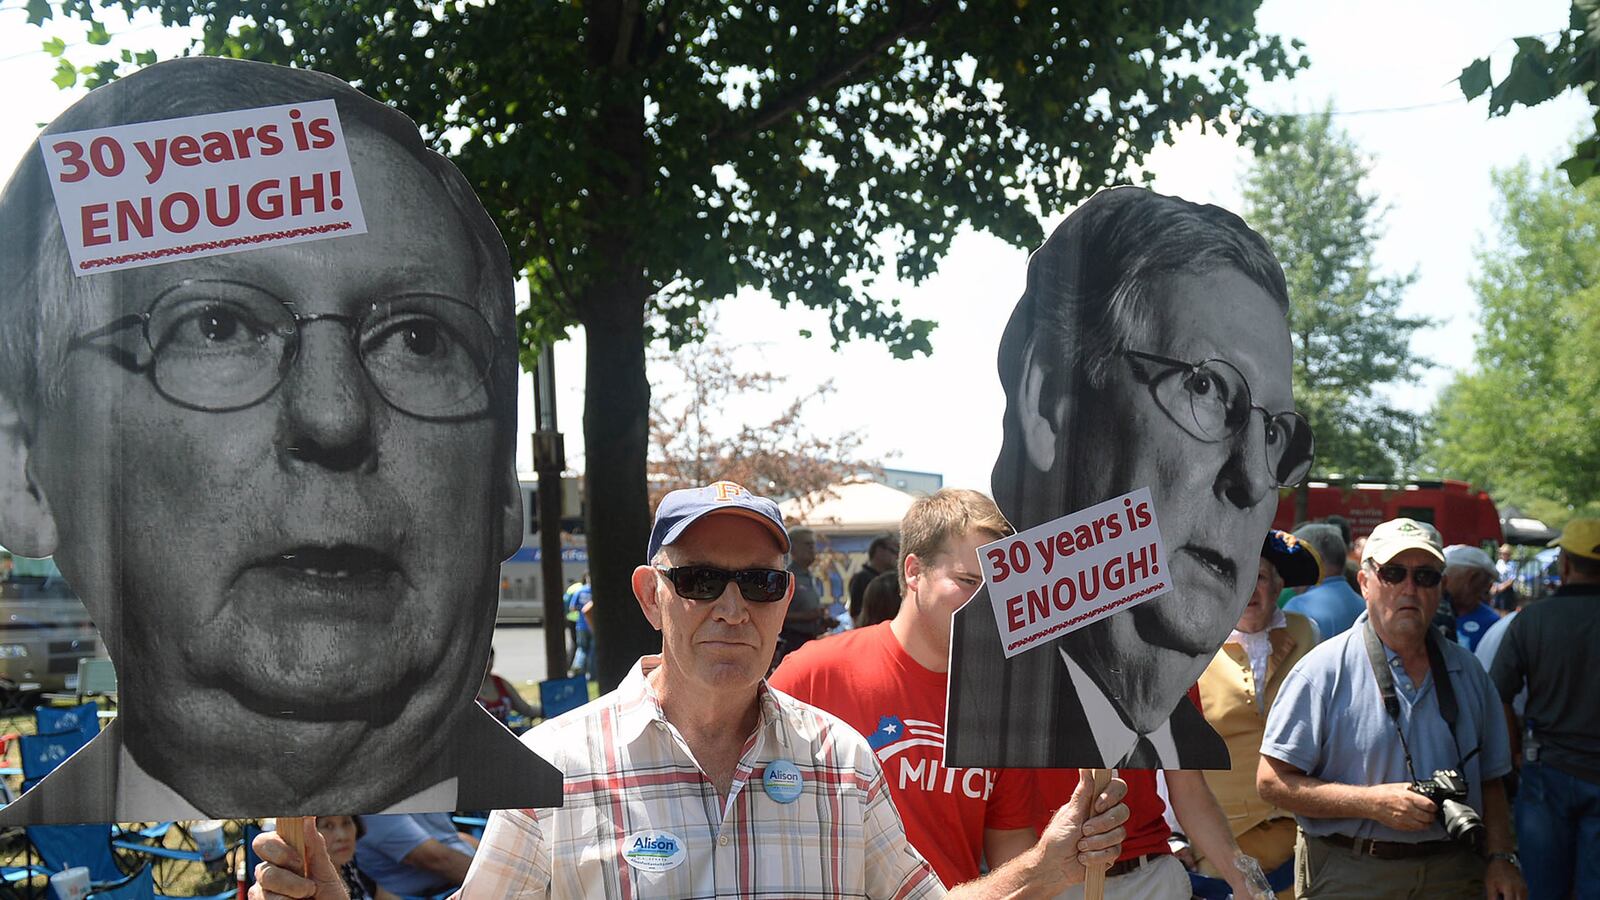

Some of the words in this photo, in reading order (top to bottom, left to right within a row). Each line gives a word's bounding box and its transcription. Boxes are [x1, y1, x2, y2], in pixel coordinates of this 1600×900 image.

[52, 136, 126, 183] 30
[133, 124, 284, 184] years
[288, 109, 335, 151] is
[80, 170, 344, 247] ENOUGH!
[986, 540, 1031, 583] 30
[1034, 513, 1122, 575] years
[1124, 498, 1152, 532] is
[1006, 542, 1159, 633] ENOUGH!
[769, 770, 798, 781] Alison
[633, 836, 674, 850] Alison
